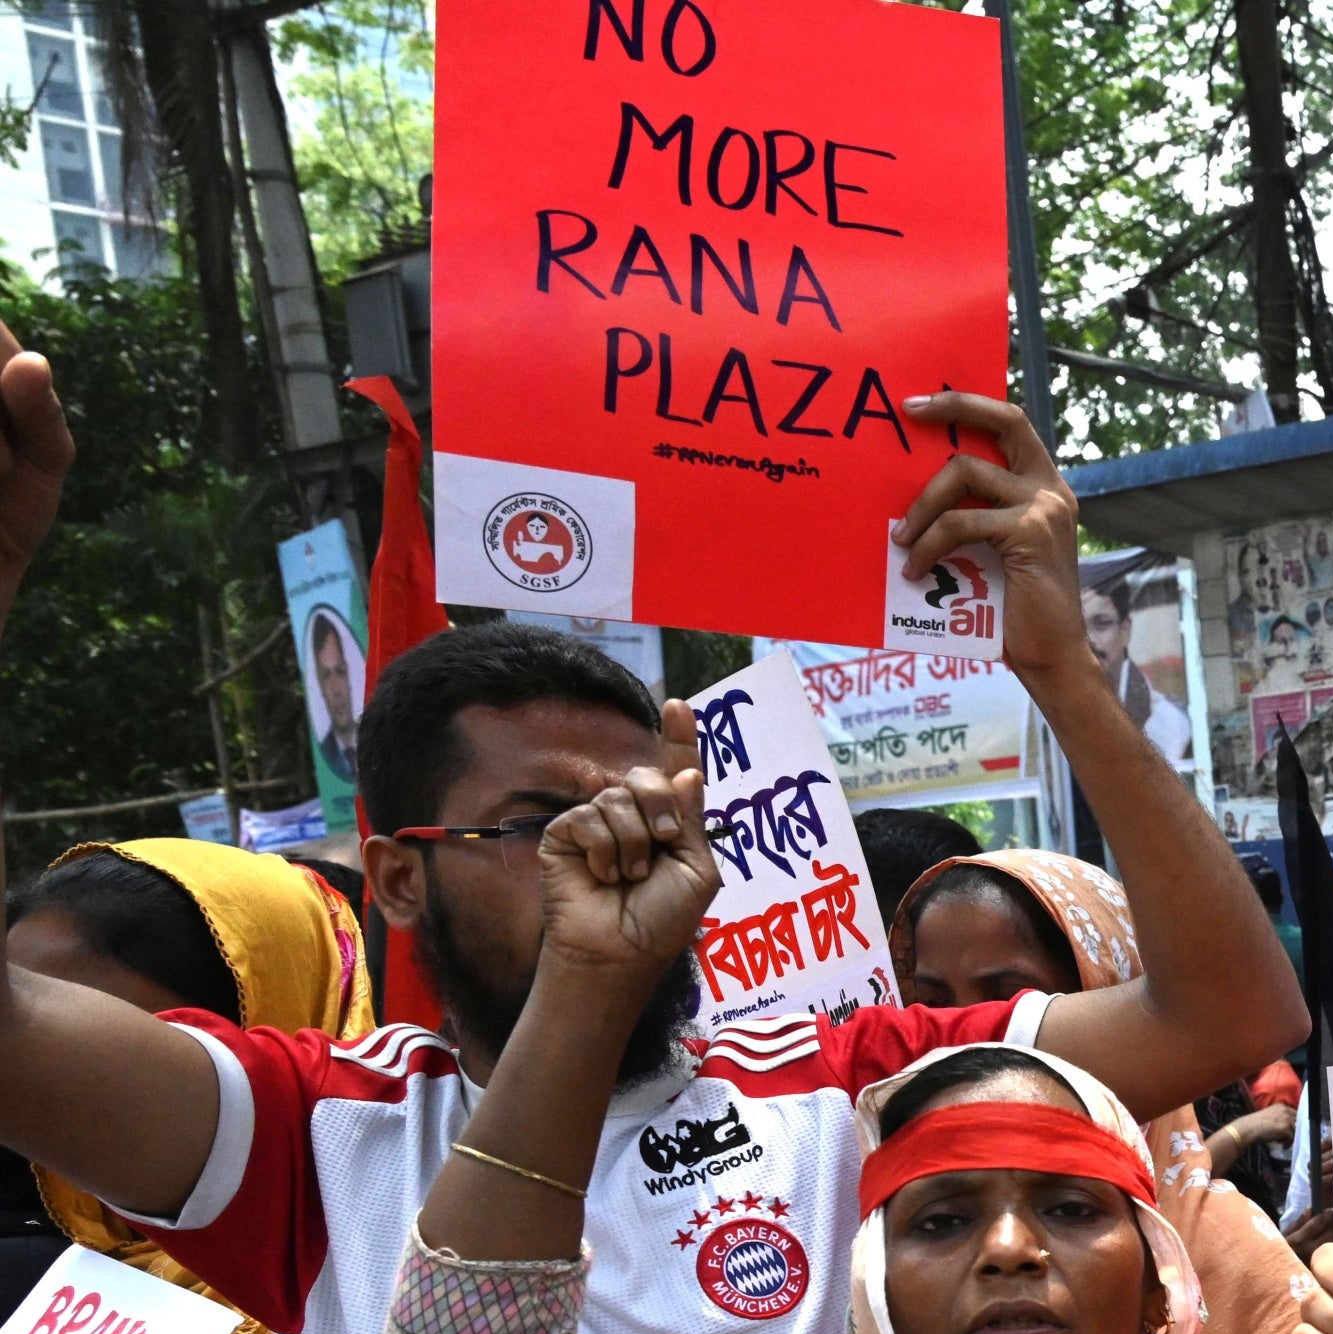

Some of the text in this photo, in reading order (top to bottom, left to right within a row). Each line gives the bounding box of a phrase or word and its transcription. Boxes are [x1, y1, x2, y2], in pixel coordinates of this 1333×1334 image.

[583, 0, 716, 77] NO
[607, 101, 903, 237] MORE
[536, 209, 842, 332] RANA
[520, 574, 560, 588] SGSF
[828, 723, 968, 766] ভাপতি পদে
[801, 860, 871, 963] চাই
[724, 1226, 792, 1250] BAYERN
[712, 1281, 792, 1313] MÜNCHEN
